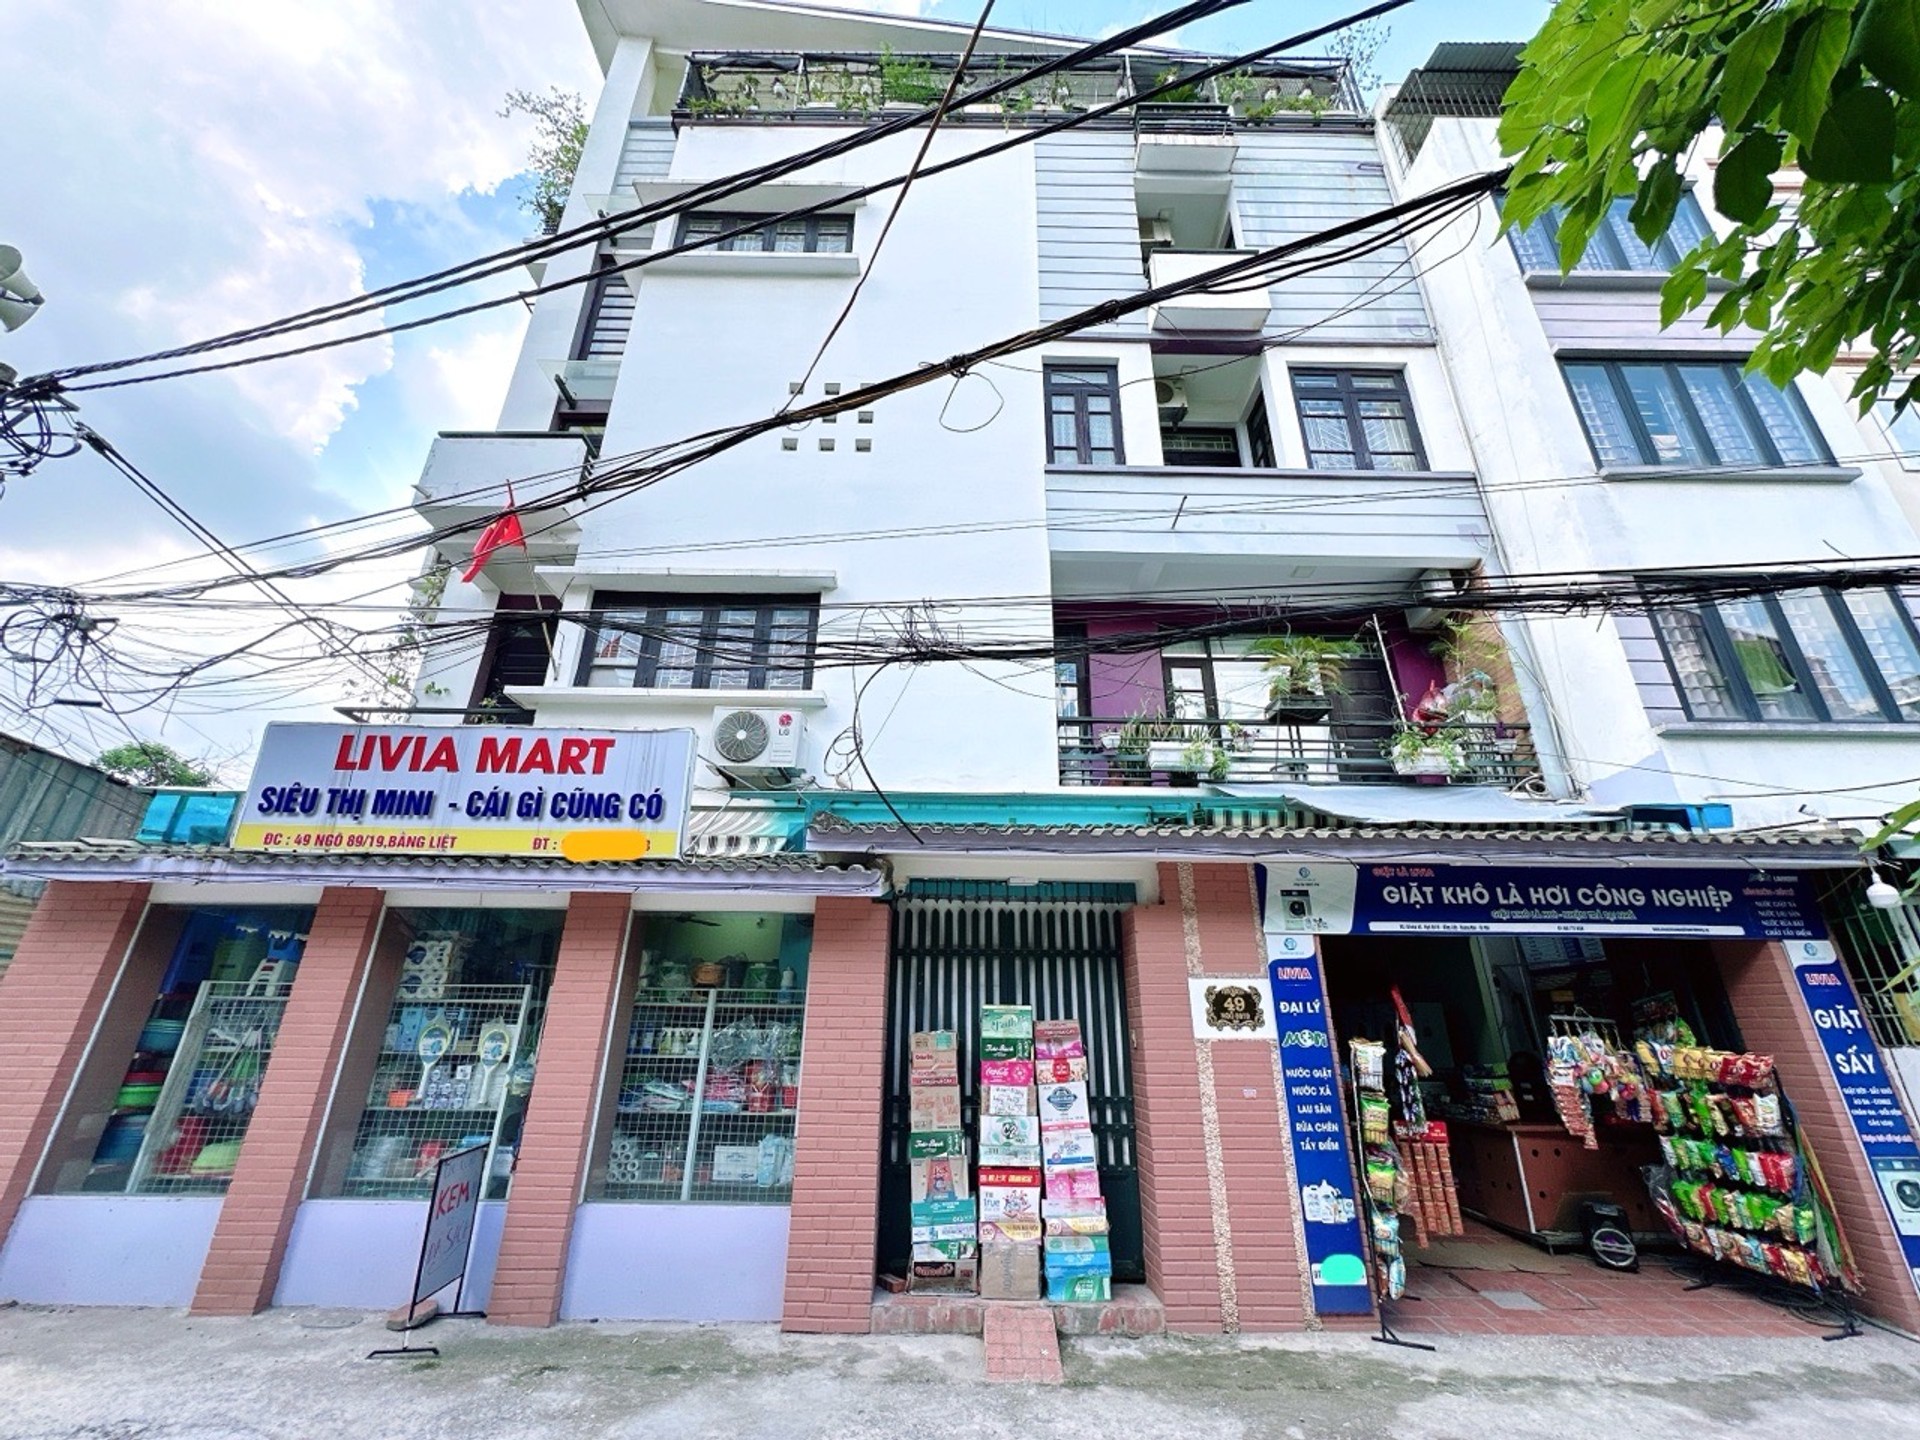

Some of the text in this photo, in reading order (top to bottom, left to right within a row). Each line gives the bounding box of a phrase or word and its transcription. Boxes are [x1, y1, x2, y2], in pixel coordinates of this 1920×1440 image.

[779, 728, 790, 736] LG
[334, 734, 616, 775] LIVIA MART
[258, 782, 319, 814] SIÊU
[326, 788, 366, 821] THỊ
[371, 789, 434, 816] MINI
[466, 786, 510, 818] CÁI
[517, 786, 544, 818] GÌ
[550, 788, 621, 819] CŨNG
[629, 788, 664, 820] CÓ
[263, 832, 284, 846] ĐC
[294, 833, 312, 846] 49
[532, 837, 550, 851] ĐT
[1382, 882, 1733, 912] GIẶT KHÔ LÀ HƠI CÔNG NGHIỆP
[1277, 967, 1313, 980] LIVIA
[1223, 997, 1246, 1012] 49
[1279, 998, 1321, 1017] ĐẠI LÝ
[1814, 1004, 1863, 1035] GIẶT
[1835, 1045, 1877, 1075] SẤY
[1297, 1104, 1314, 1115] LAU
[436, 1181, 470, 1220] KEM
